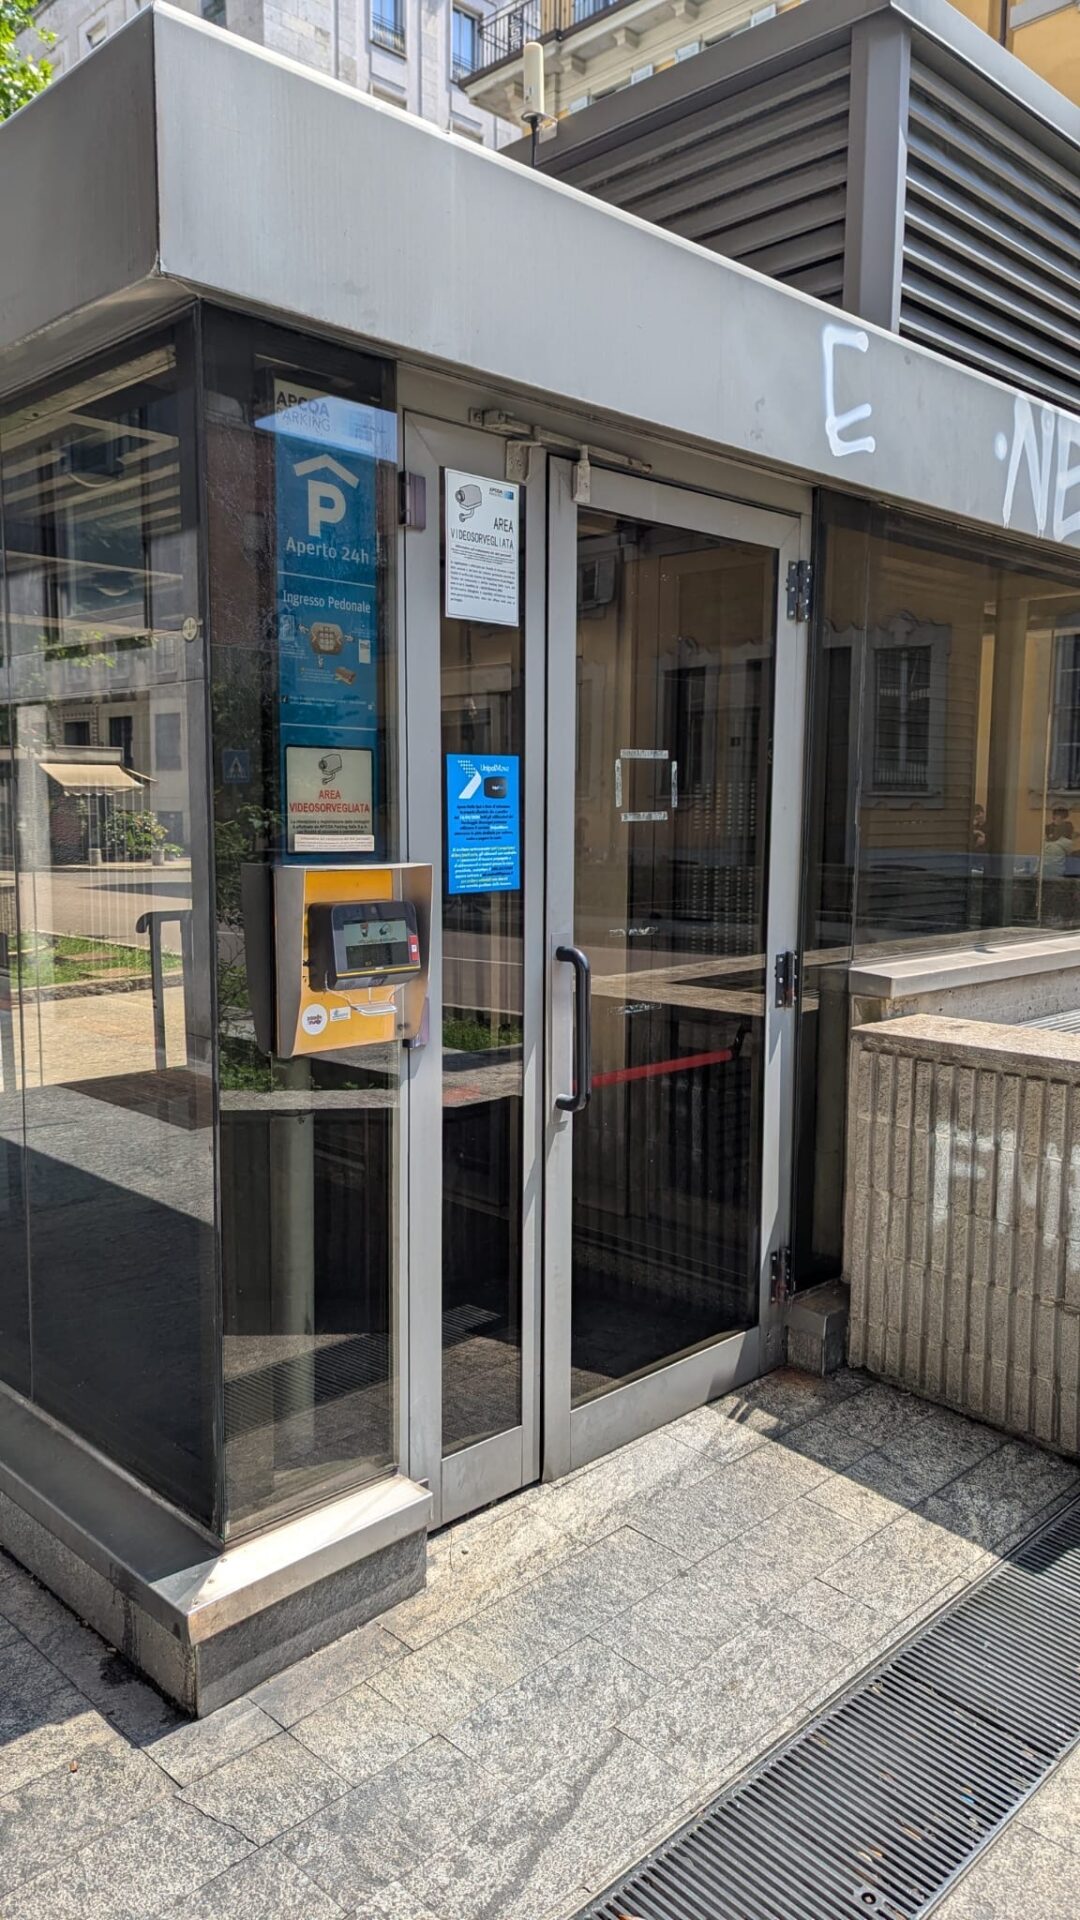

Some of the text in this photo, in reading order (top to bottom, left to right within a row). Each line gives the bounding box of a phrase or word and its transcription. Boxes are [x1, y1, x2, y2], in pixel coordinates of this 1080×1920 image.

[277, 391, 329, 418] APCOA
[276, 406, 331, 432] PARKING
[308, 480, 346, 538] P
[493, 517, 514, 533] AREA
[286, 536, 369, 565] Aperto 24h
[450, 528, 514, 550] VIDEOSORVEGLIATA
[282, 590, 371, 613] Ingresso Pedonale
[318, 790, 341, 800] AREA
[289, 802, 370, 813] VIDEOSORVEGLIATA
